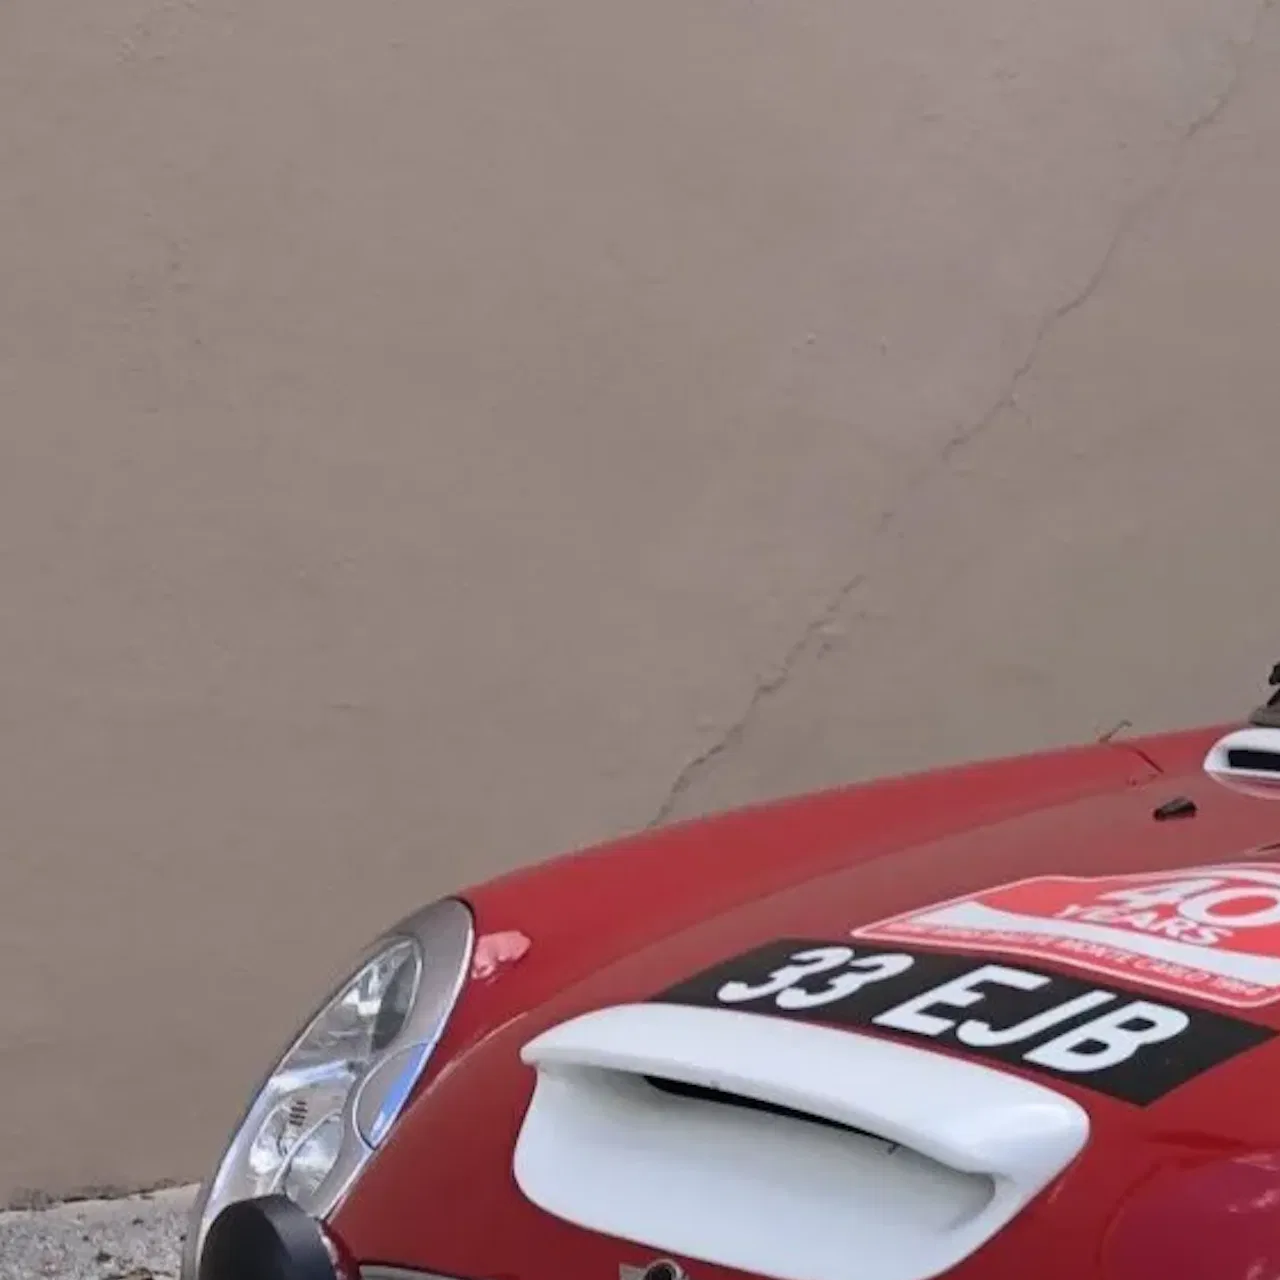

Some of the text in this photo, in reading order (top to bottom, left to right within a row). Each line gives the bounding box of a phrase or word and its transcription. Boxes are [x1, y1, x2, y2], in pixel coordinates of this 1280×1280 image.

[1051, 904, 1234, 945] YEARS
[716, 946, 1190, 1073] 33 EJB
